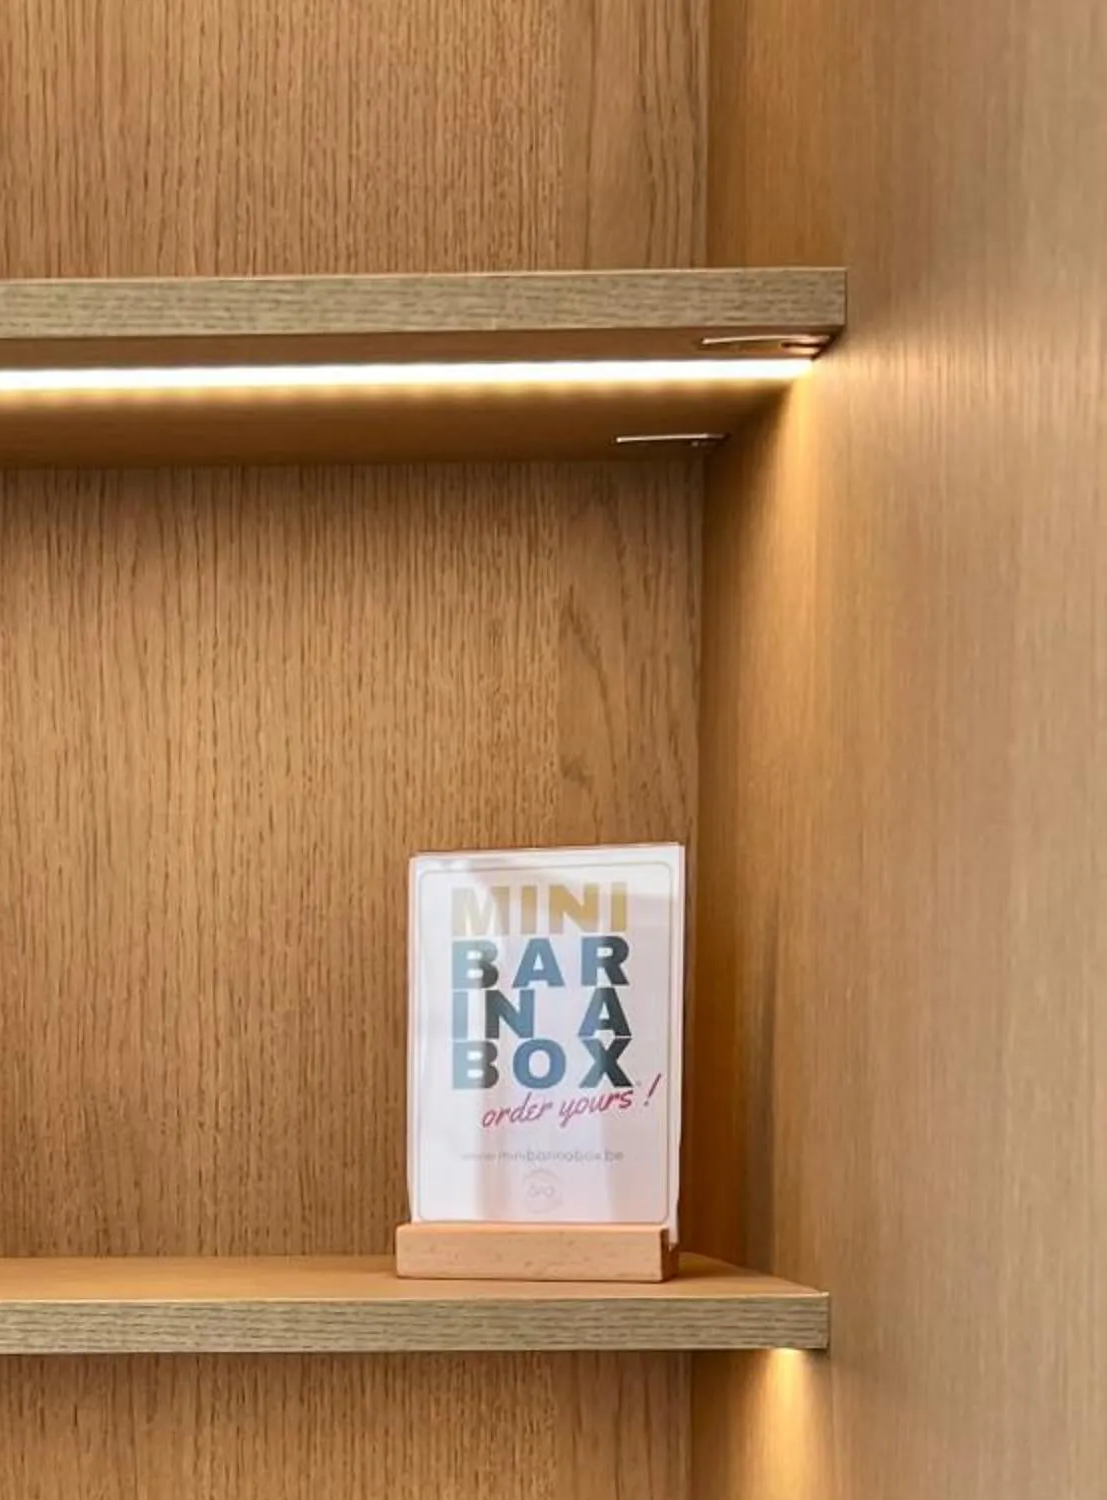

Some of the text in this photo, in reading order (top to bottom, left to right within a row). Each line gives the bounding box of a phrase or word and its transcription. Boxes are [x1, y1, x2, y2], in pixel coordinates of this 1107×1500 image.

[452, 882, 627, 935] MINI
[452, 936, 629, 989] BAR
[452, 987, 632, 1039] IN A
[452, 1037, 634, 1090] BOX
[482, 1092, 553, 1128] order
[557, 1089, 634, 1126] yours
